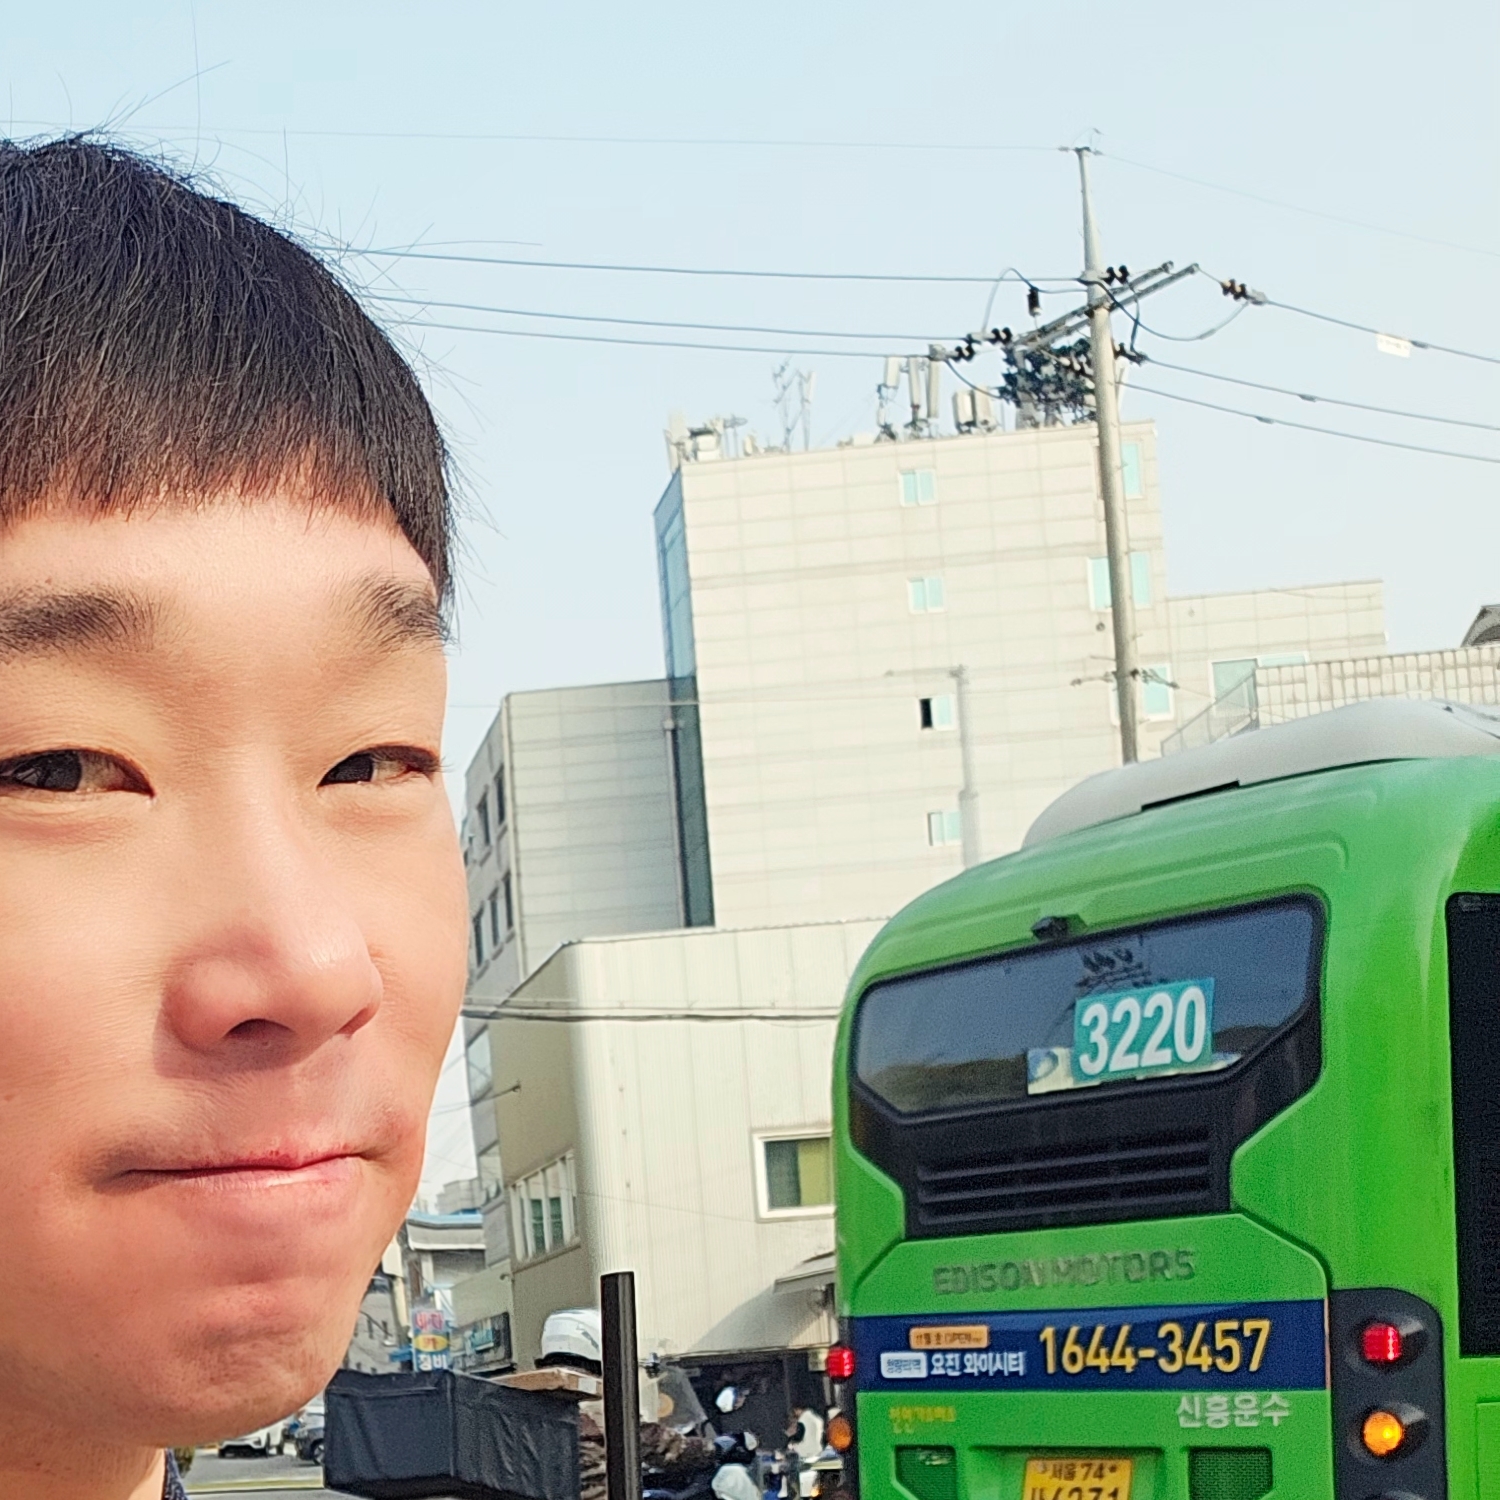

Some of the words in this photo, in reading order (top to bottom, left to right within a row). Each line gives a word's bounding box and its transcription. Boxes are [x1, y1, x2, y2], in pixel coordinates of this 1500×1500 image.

[1079, 986, 1206, 1075] 3220
[932, 1260, 1044, 1295] EDISON
[1049, 1249, 1197, 1287] MOTORS
[930, 1353, 961, 1377] 요진
[963, 1352, 1027, 1377] 와이시티
[1040, 1318, 1271, 1374] 1644-3457
[1176, 1393, 1290, 1429] 신흥운수
